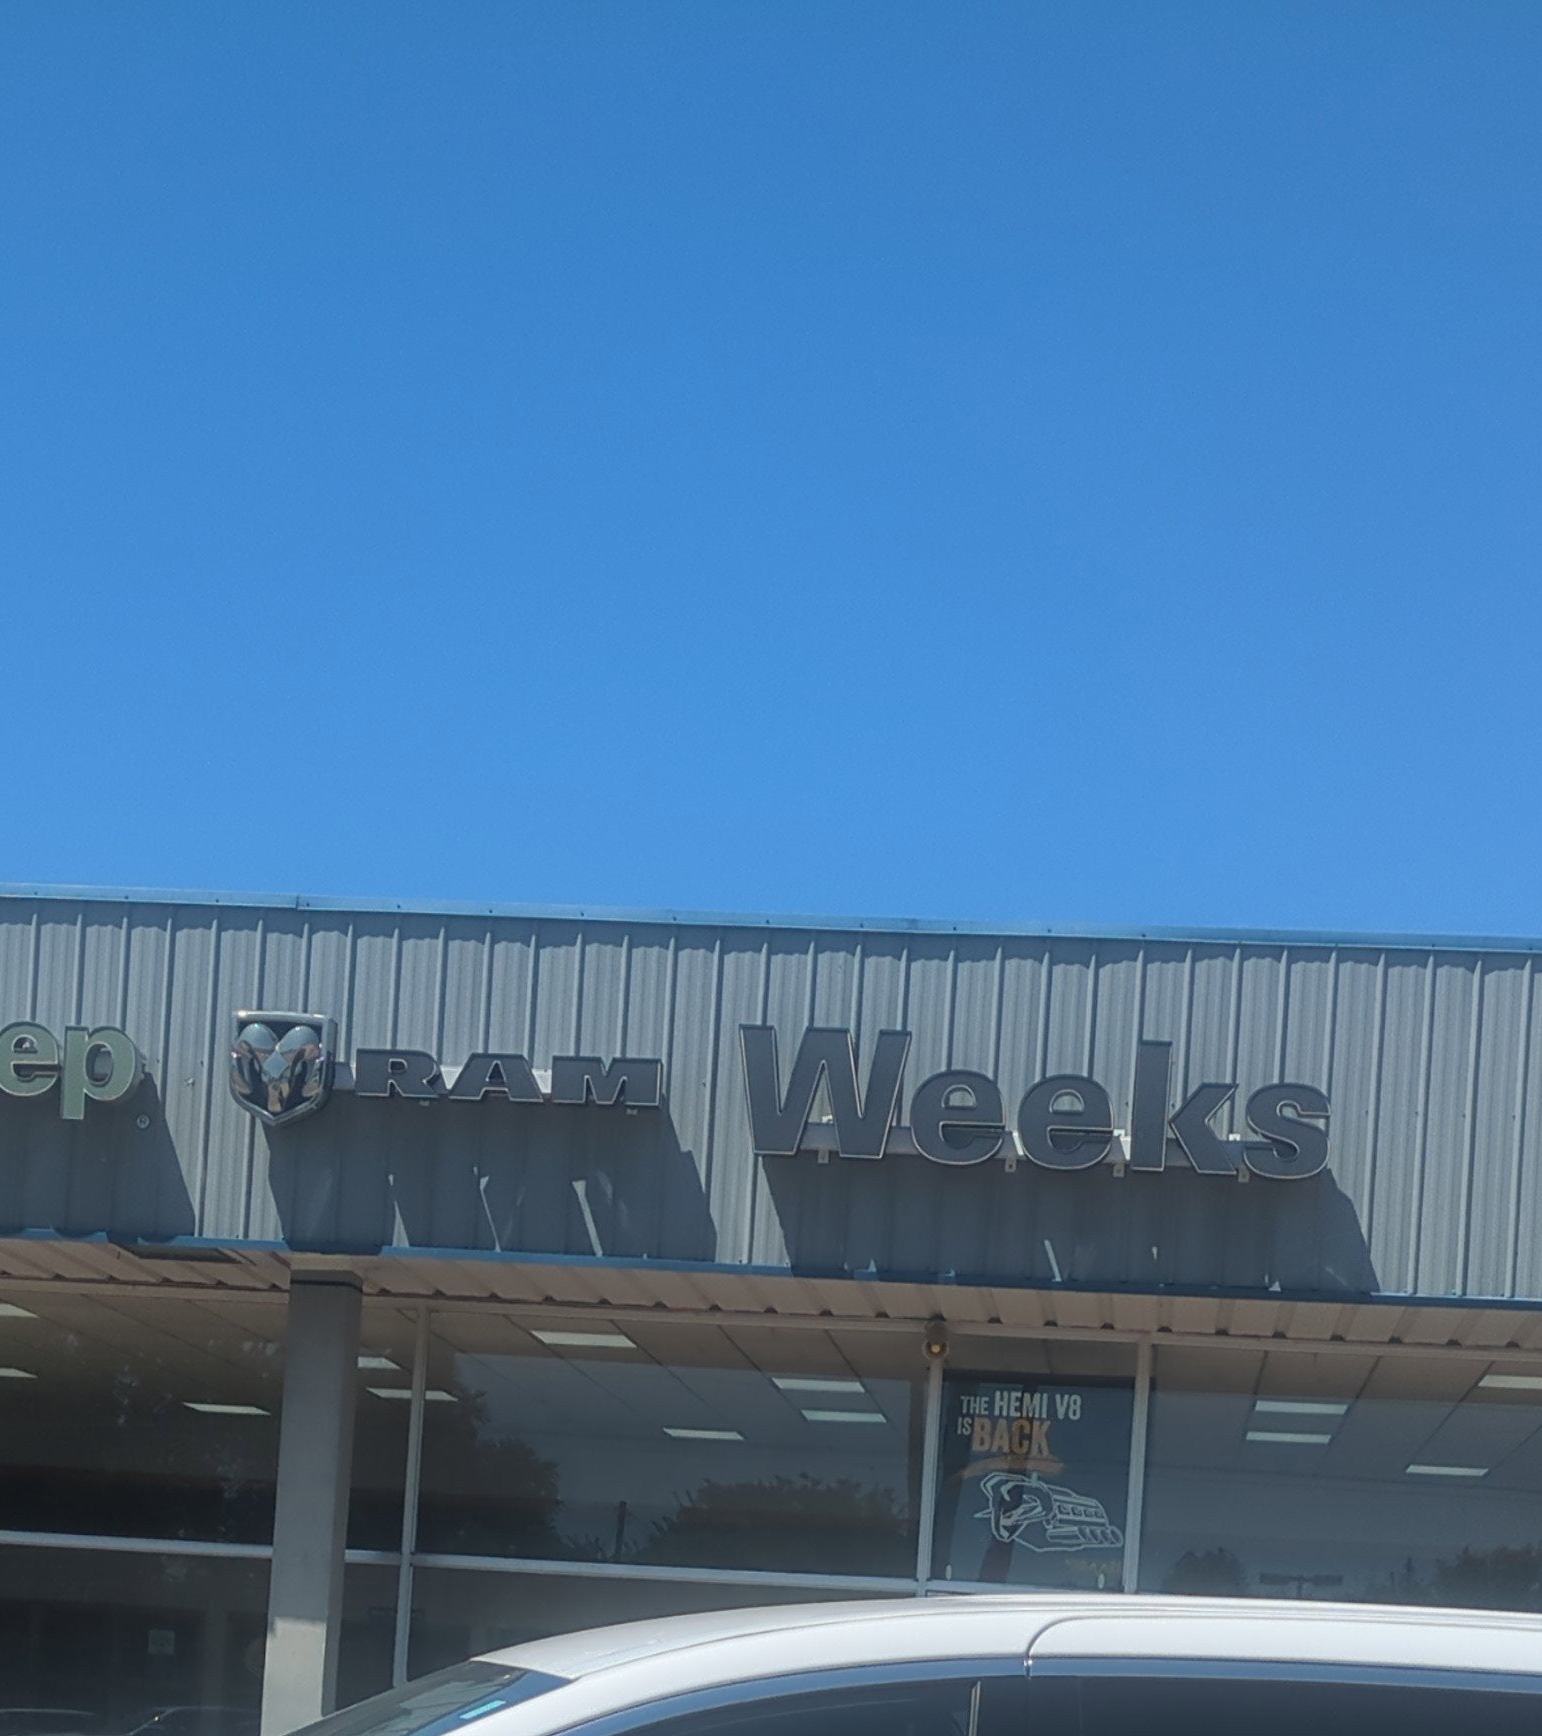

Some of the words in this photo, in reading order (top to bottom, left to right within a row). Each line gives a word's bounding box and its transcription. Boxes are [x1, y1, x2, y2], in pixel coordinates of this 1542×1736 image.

[356, 1048, 663, 1108] RAM
[739, 1023, 1332, 1180] Weeks
[961, 1395, 989, 1415] THE
[994, 1390, 1048, 1419] HEMI
[1055, 1394, 1082, 1420] V8
[957, 1417, 972, 1436] IS
[971, 1417, 1051, 1458] BACK
